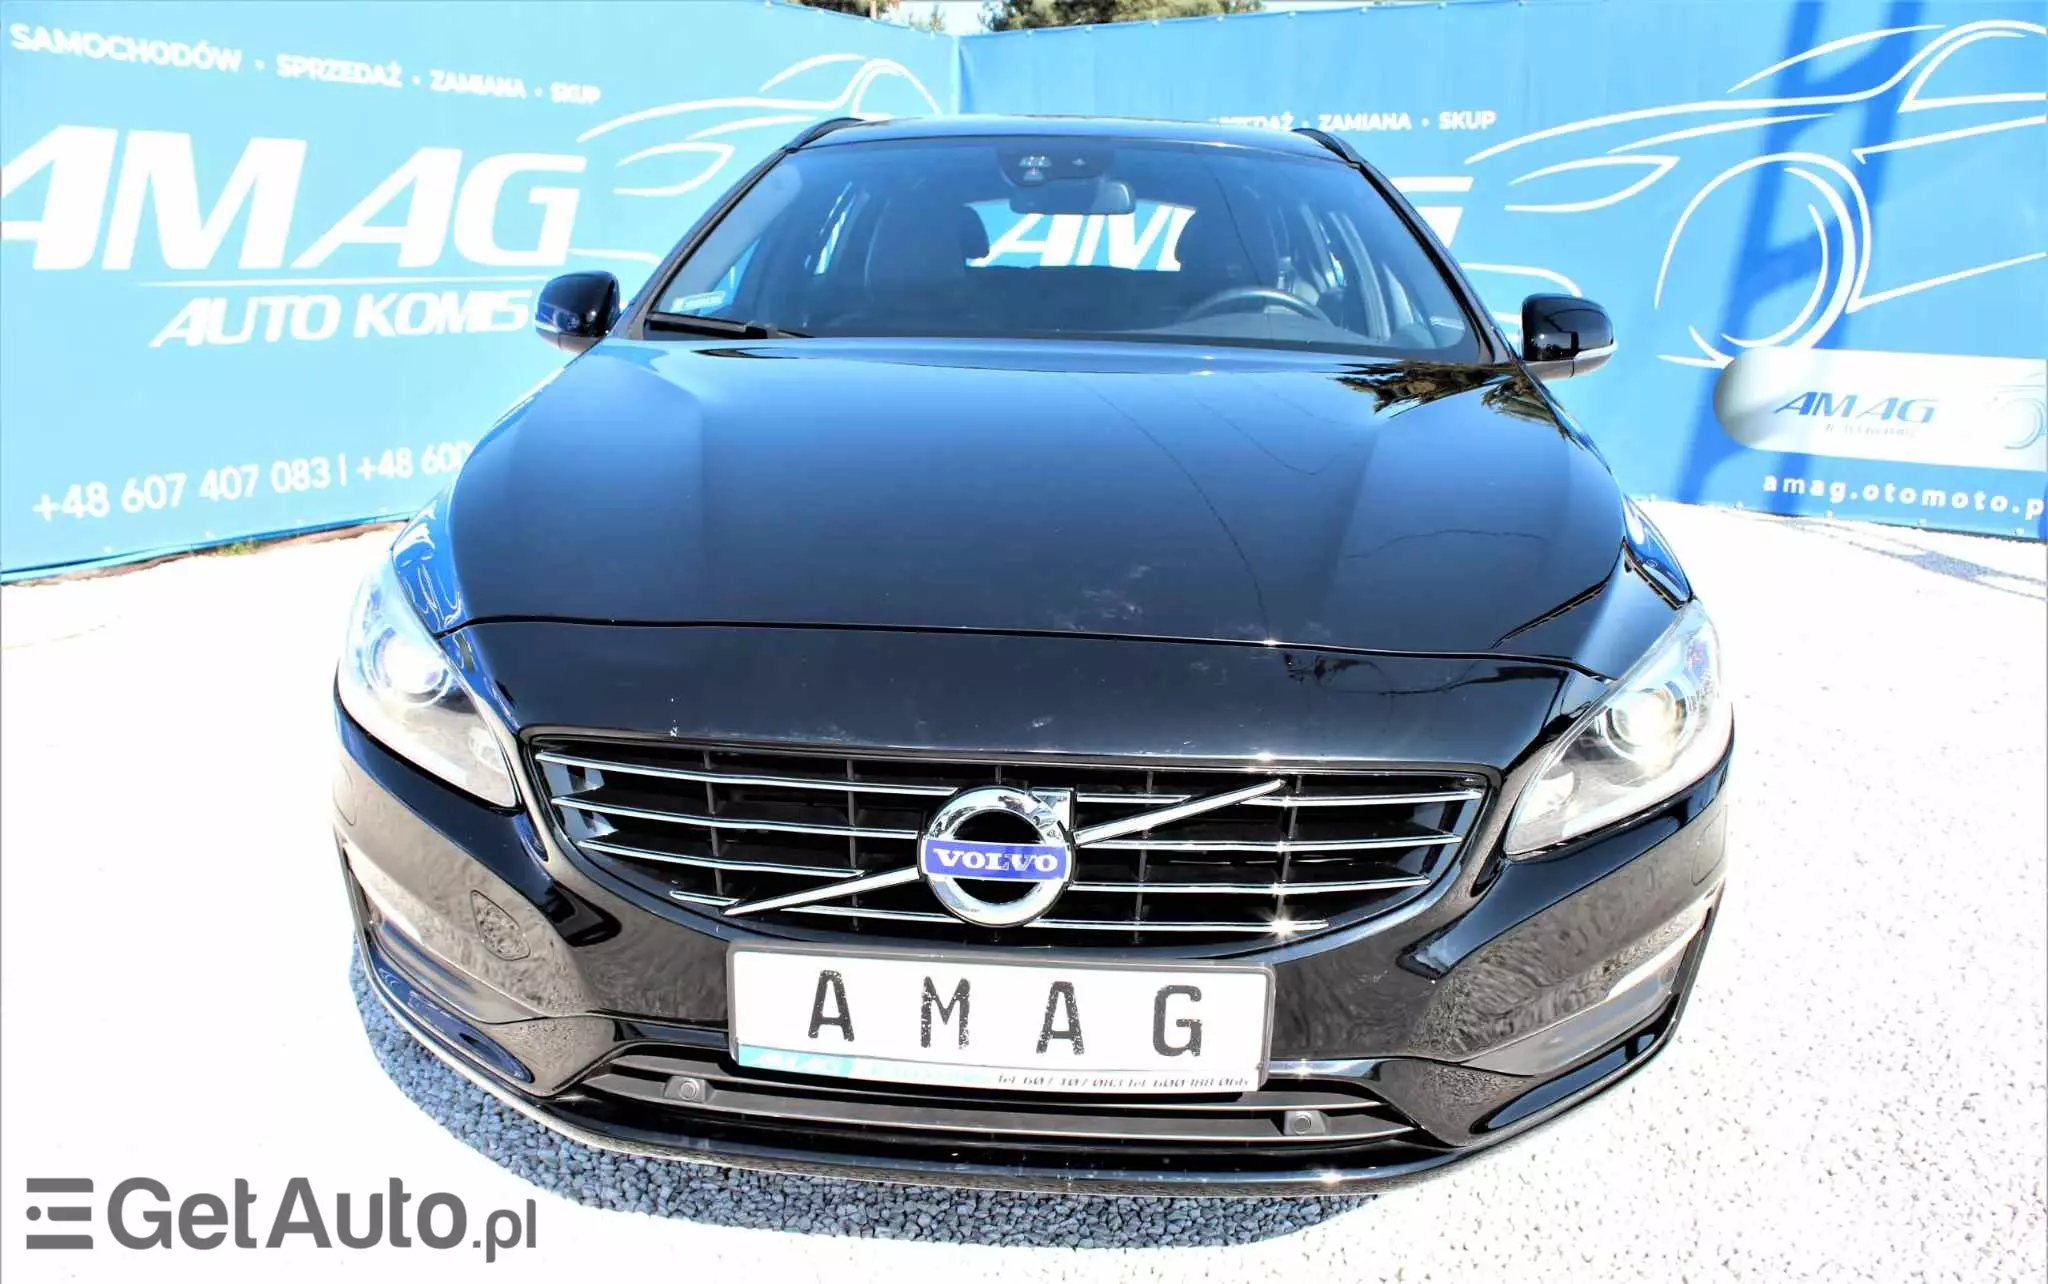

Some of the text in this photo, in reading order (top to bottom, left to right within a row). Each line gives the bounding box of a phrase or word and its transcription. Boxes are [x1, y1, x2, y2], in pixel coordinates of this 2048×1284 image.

[10, 23, 601, 105] SAMOCHODÓW SPRZEDAŻ ZAMIANA SKUP
[1319, 112, 1412, 132] ZAMIANA
[1439, 110, 1496, 130] SKUP
[149, 294, 342, 348] AUTO
[33, 482, 111, 521] +48
[121, 473, 187, 513] 607
[199, 464, 260, 502] 407
[270, 456, 331, 494] 083
[356, 447, 414, 481] +48
[932, 848, 1058, 872] VOLVO
